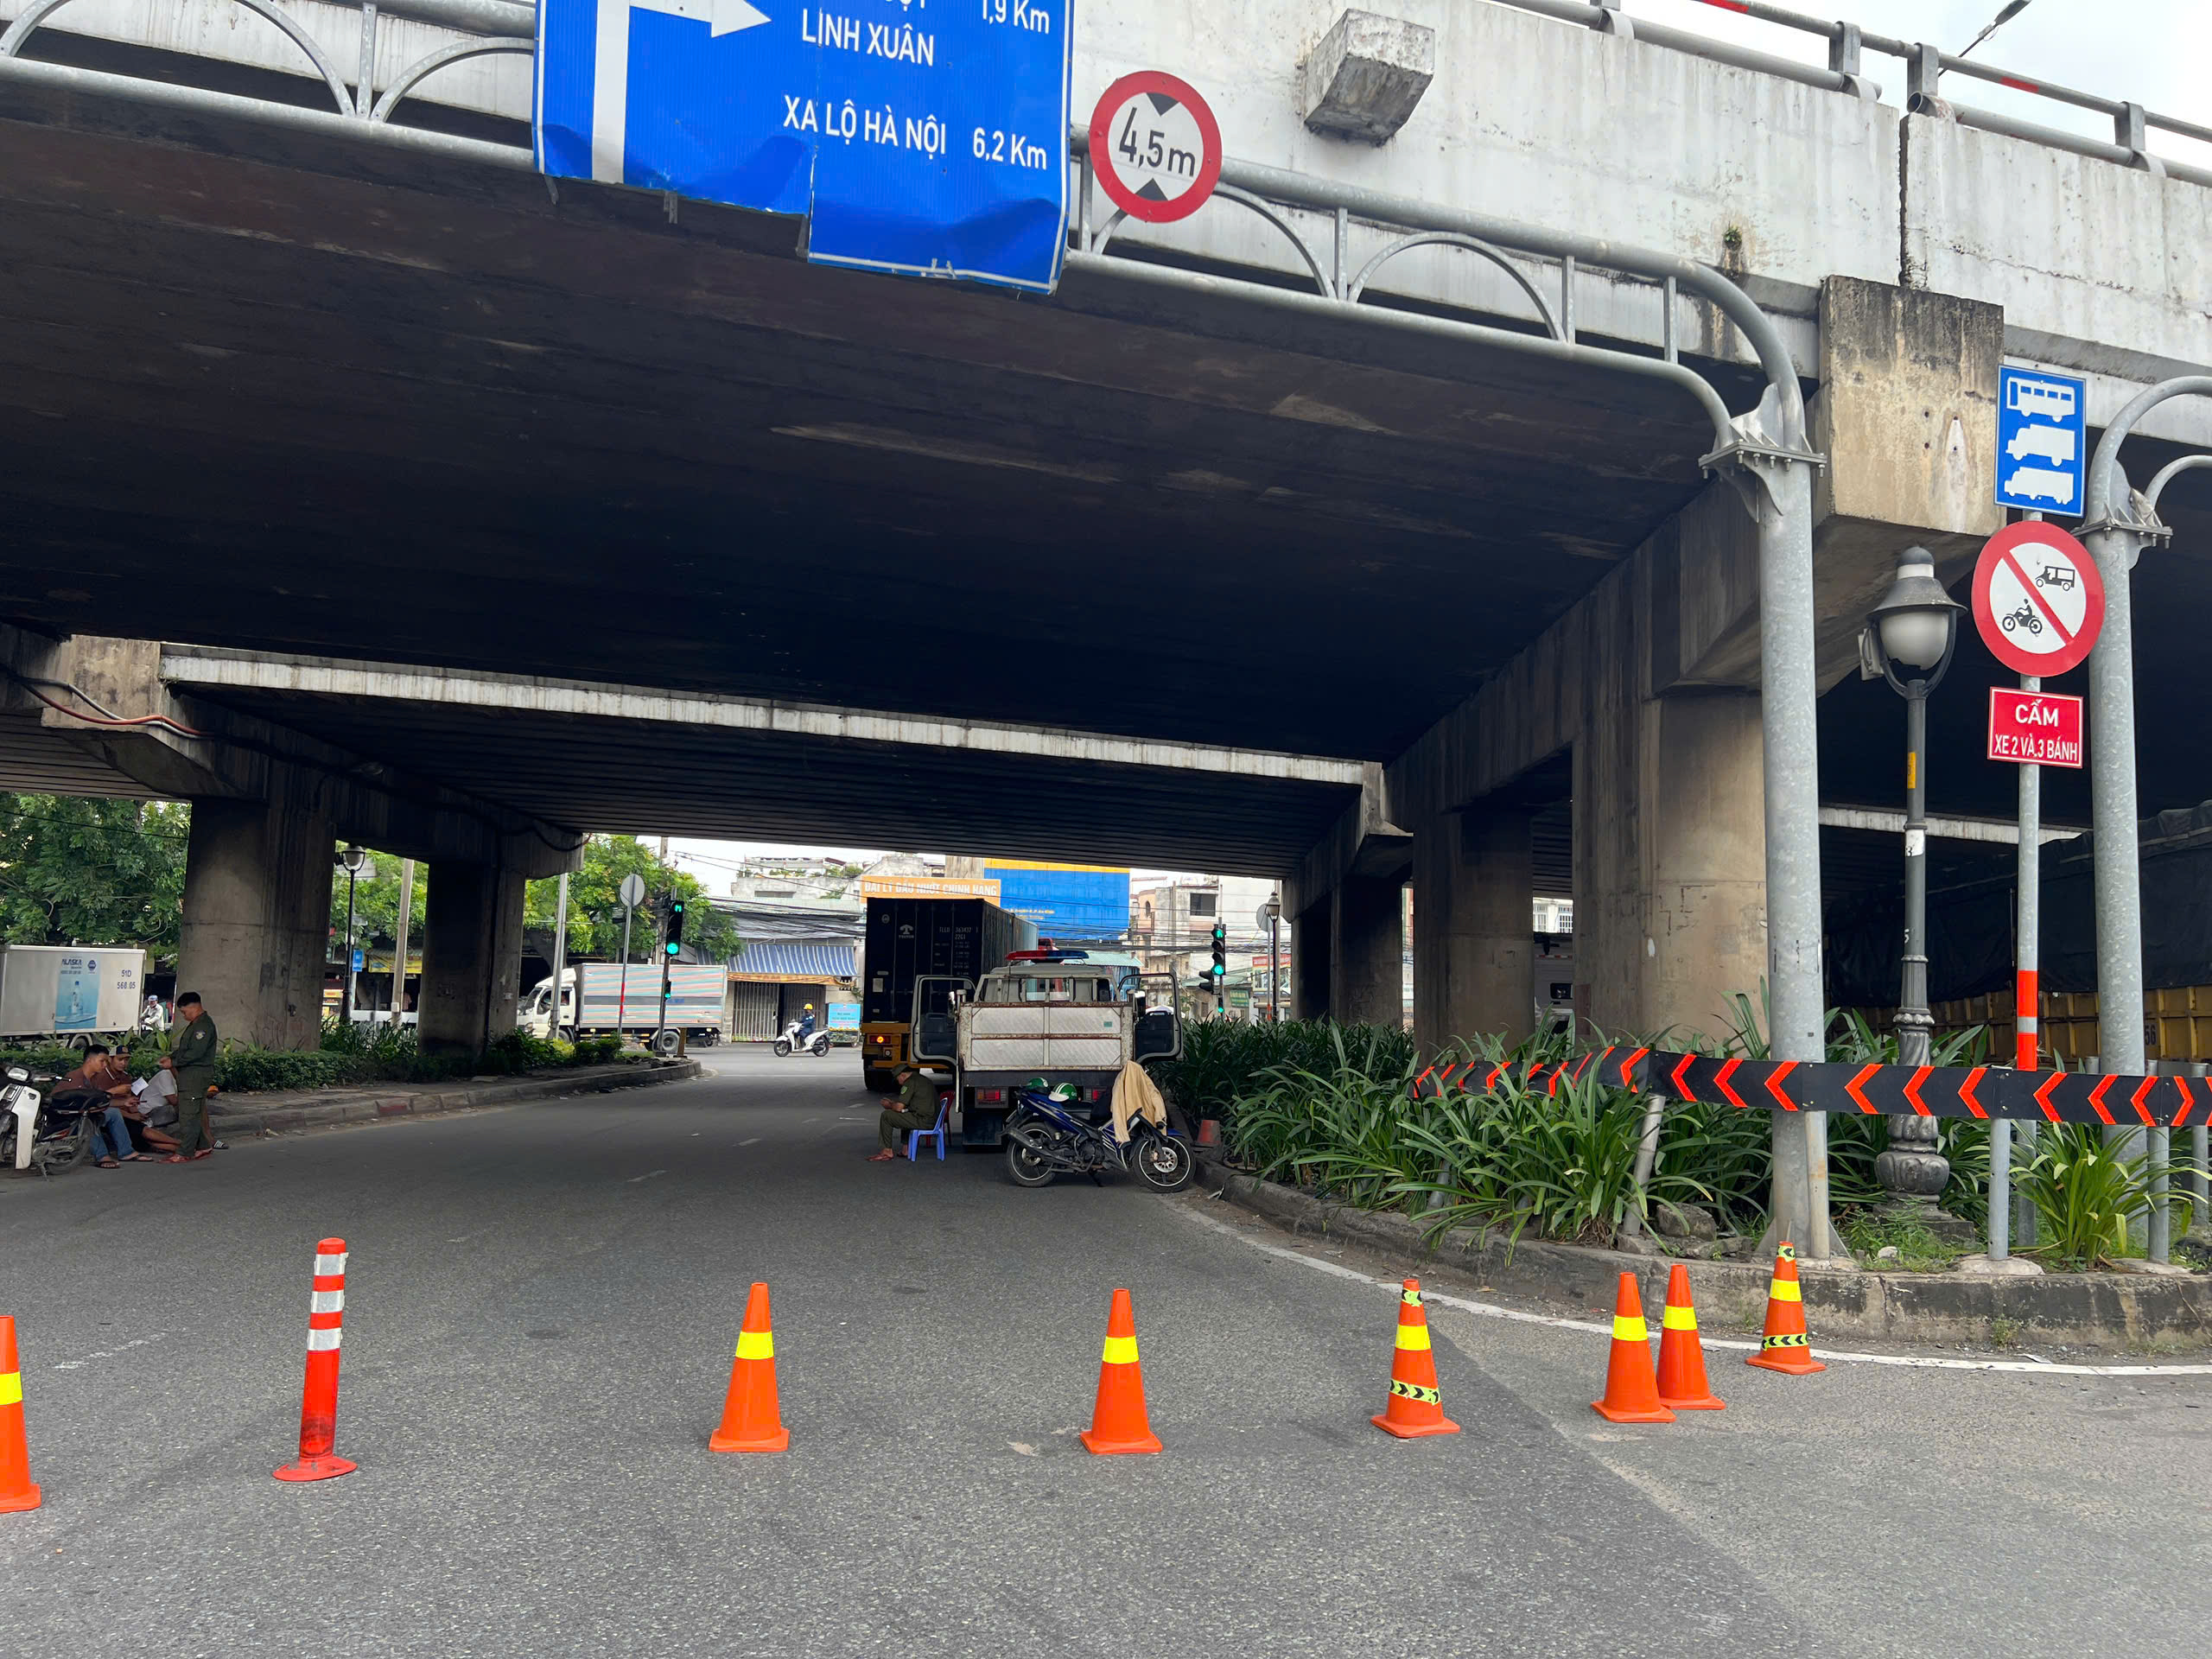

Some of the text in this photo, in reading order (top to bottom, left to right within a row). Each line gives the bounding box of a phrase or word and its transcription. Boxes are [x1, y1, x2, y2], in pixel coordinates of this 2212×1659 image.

[1014, 0, 1049, 34] Km
[802, 9, 933, 67] LINH XUÂN
[783, 94, 945, 159] XA LỘ HÀ NỘI
[973, 127, 1046, 170] 6,2 Km
[2015, 698, 2059, 728] CẤM
[1994, 734, 2010, 754] XE
[2011, 736, 2018, 755] 2
[2047, 735, 2077, 761] BÁNH
